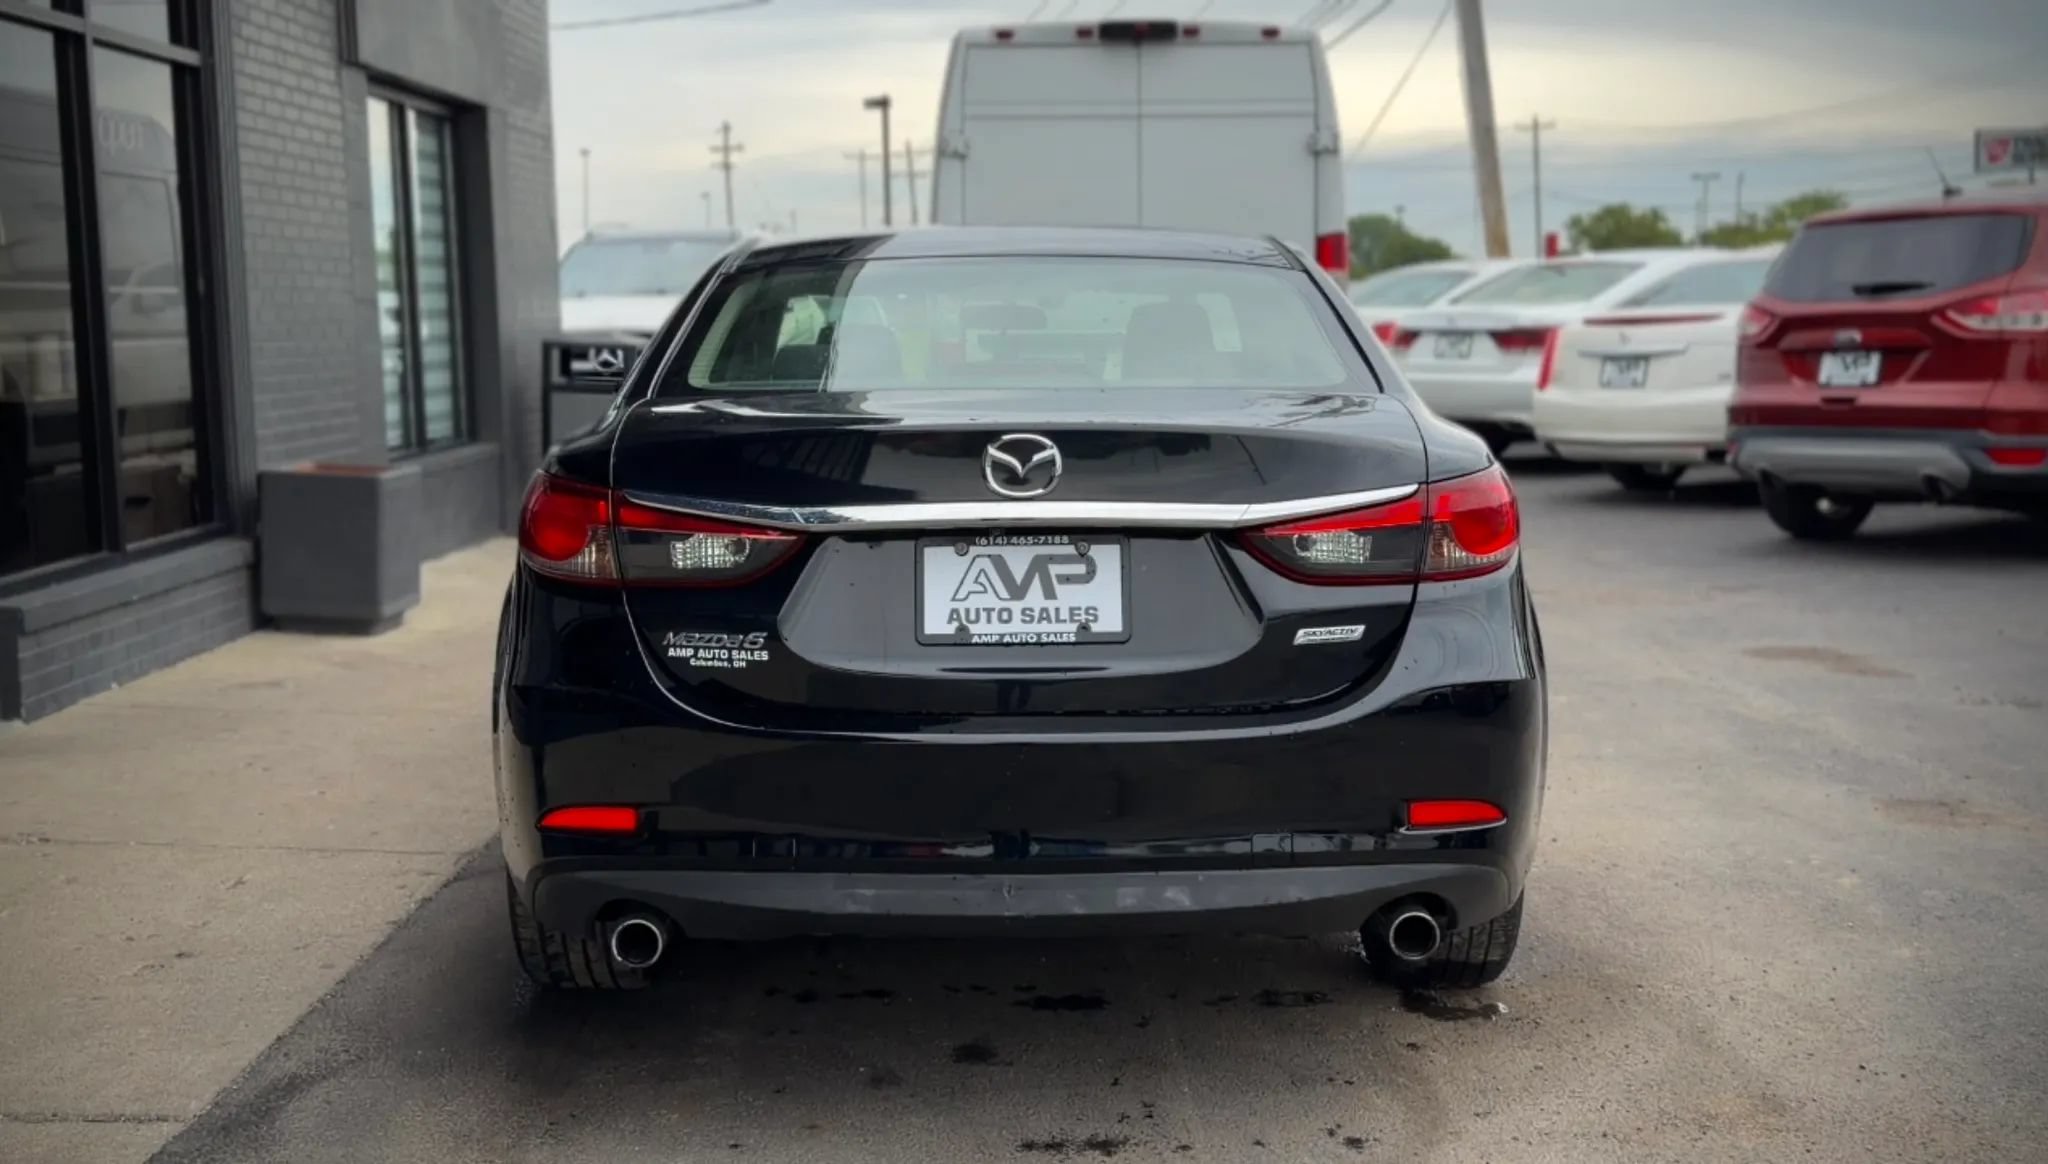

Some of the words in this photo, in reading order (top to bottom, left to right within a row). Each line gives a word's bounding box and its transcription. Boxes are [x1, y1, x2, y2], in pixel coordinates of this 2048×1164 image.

[975, 536, 1007, 545] (614)
[950, 554, 1098, 601] AMP
[946, 607, 1013, 625] AUTO
[1020, 606, 1099, 624] SALES
[971, 634, 1000, 643] AMP
[1003, 633, 1037, 643] AUTO
[1040, 633, 1076, 643] SALES
[667, 647, 694, 657] AMP
[697, 649, 729, 659] AUTO
[731, 650, 769, 661] SALES
[733, 660, 746, 668] OH
